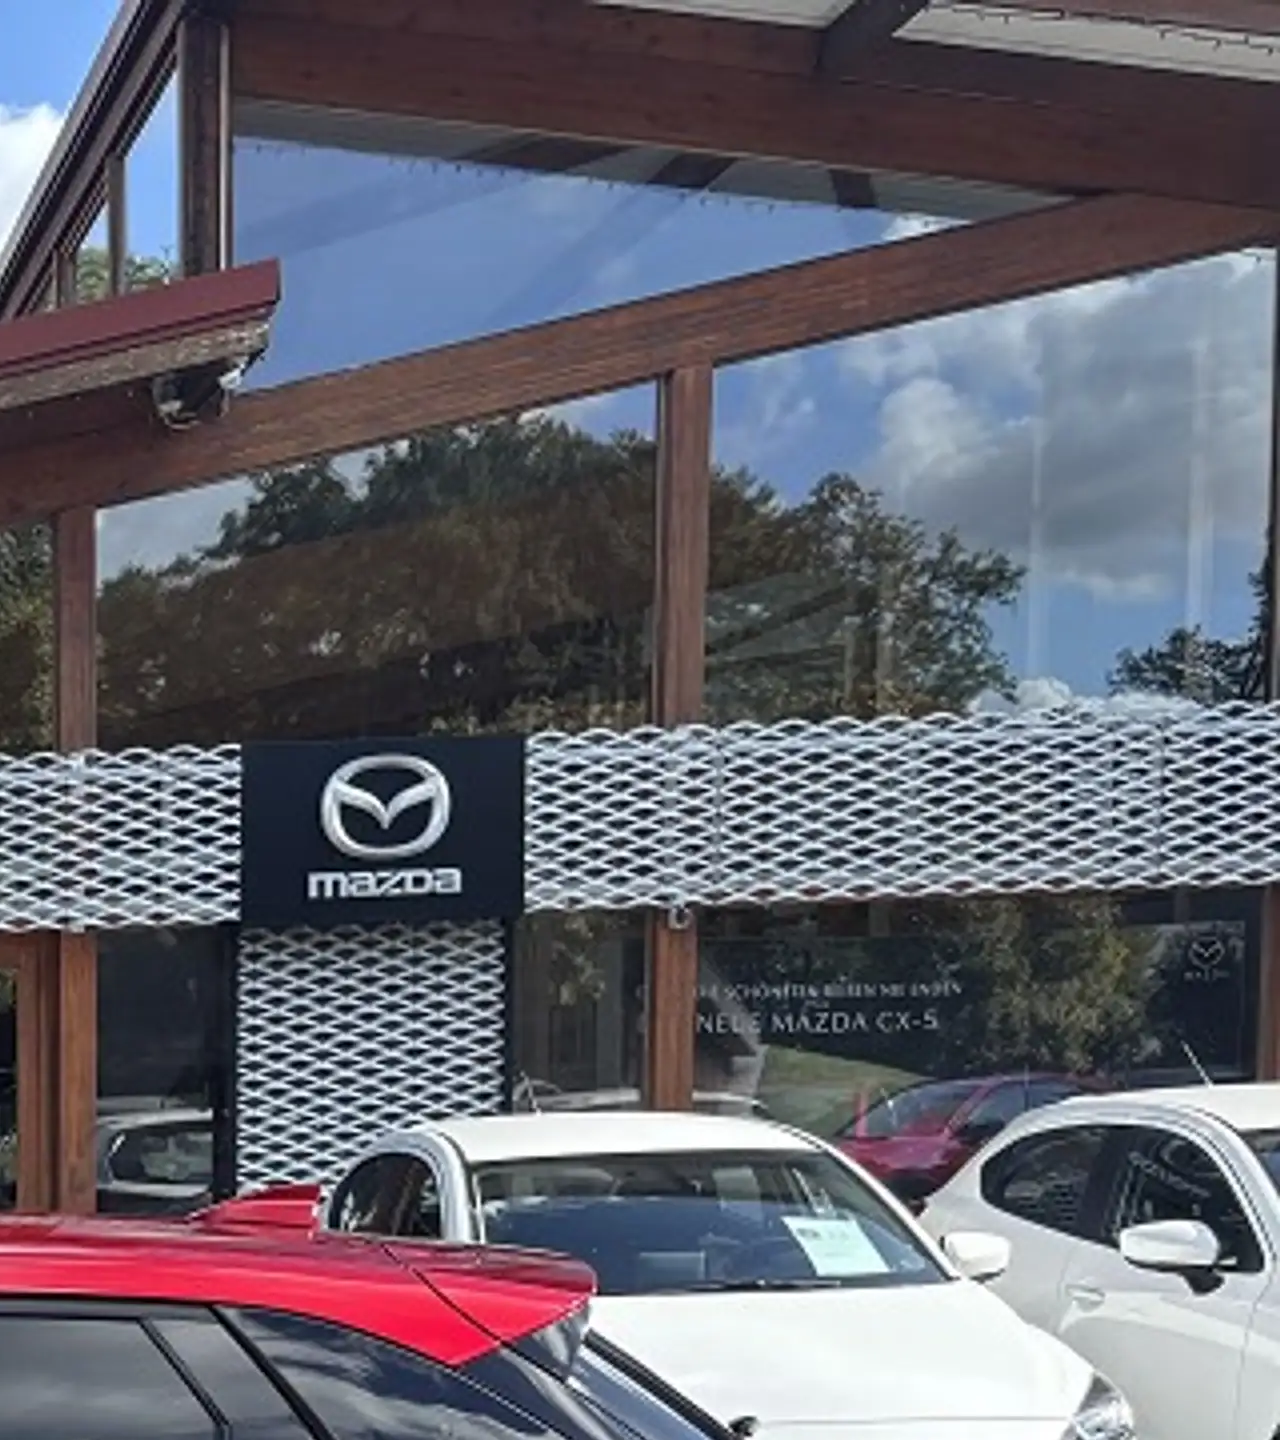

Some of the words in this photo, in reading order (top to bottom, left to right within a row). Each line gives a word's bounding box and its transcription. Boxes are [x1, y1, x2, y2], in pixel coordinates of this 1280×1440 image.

[307, 867, 463, 898] mazda
[771, 1011, 870, 1034] MAZDA
[876, 1007, 939, 1033] CX-5
